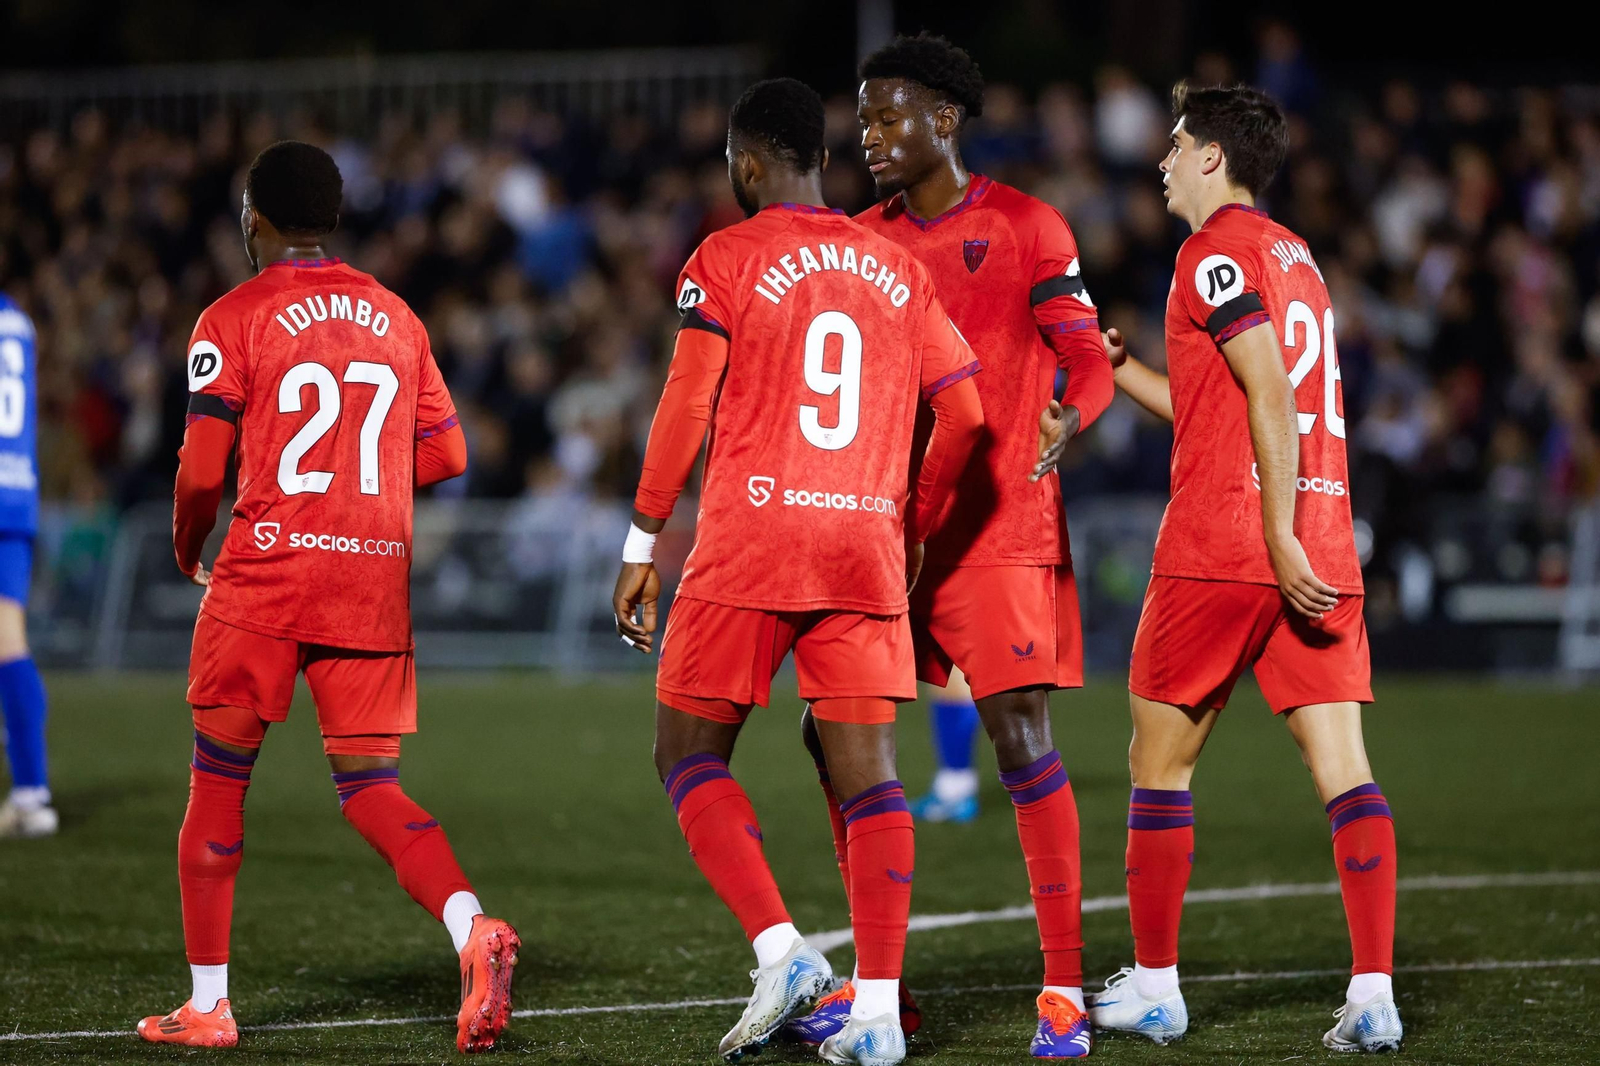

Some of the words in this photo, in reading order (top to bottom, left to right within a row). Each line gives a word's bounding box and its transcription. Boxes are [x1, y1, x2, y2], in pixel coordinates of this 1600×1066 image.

[755, 243, 911, 309] IHEANACHO
[1207, 263, 1237, 301] JD
[275, 294, 390, 337] IDUMBO
[799, 310, 863, 450] 9
[277, 361, 400, 496] 27
[1039, 883, 1067, 894] SFC
